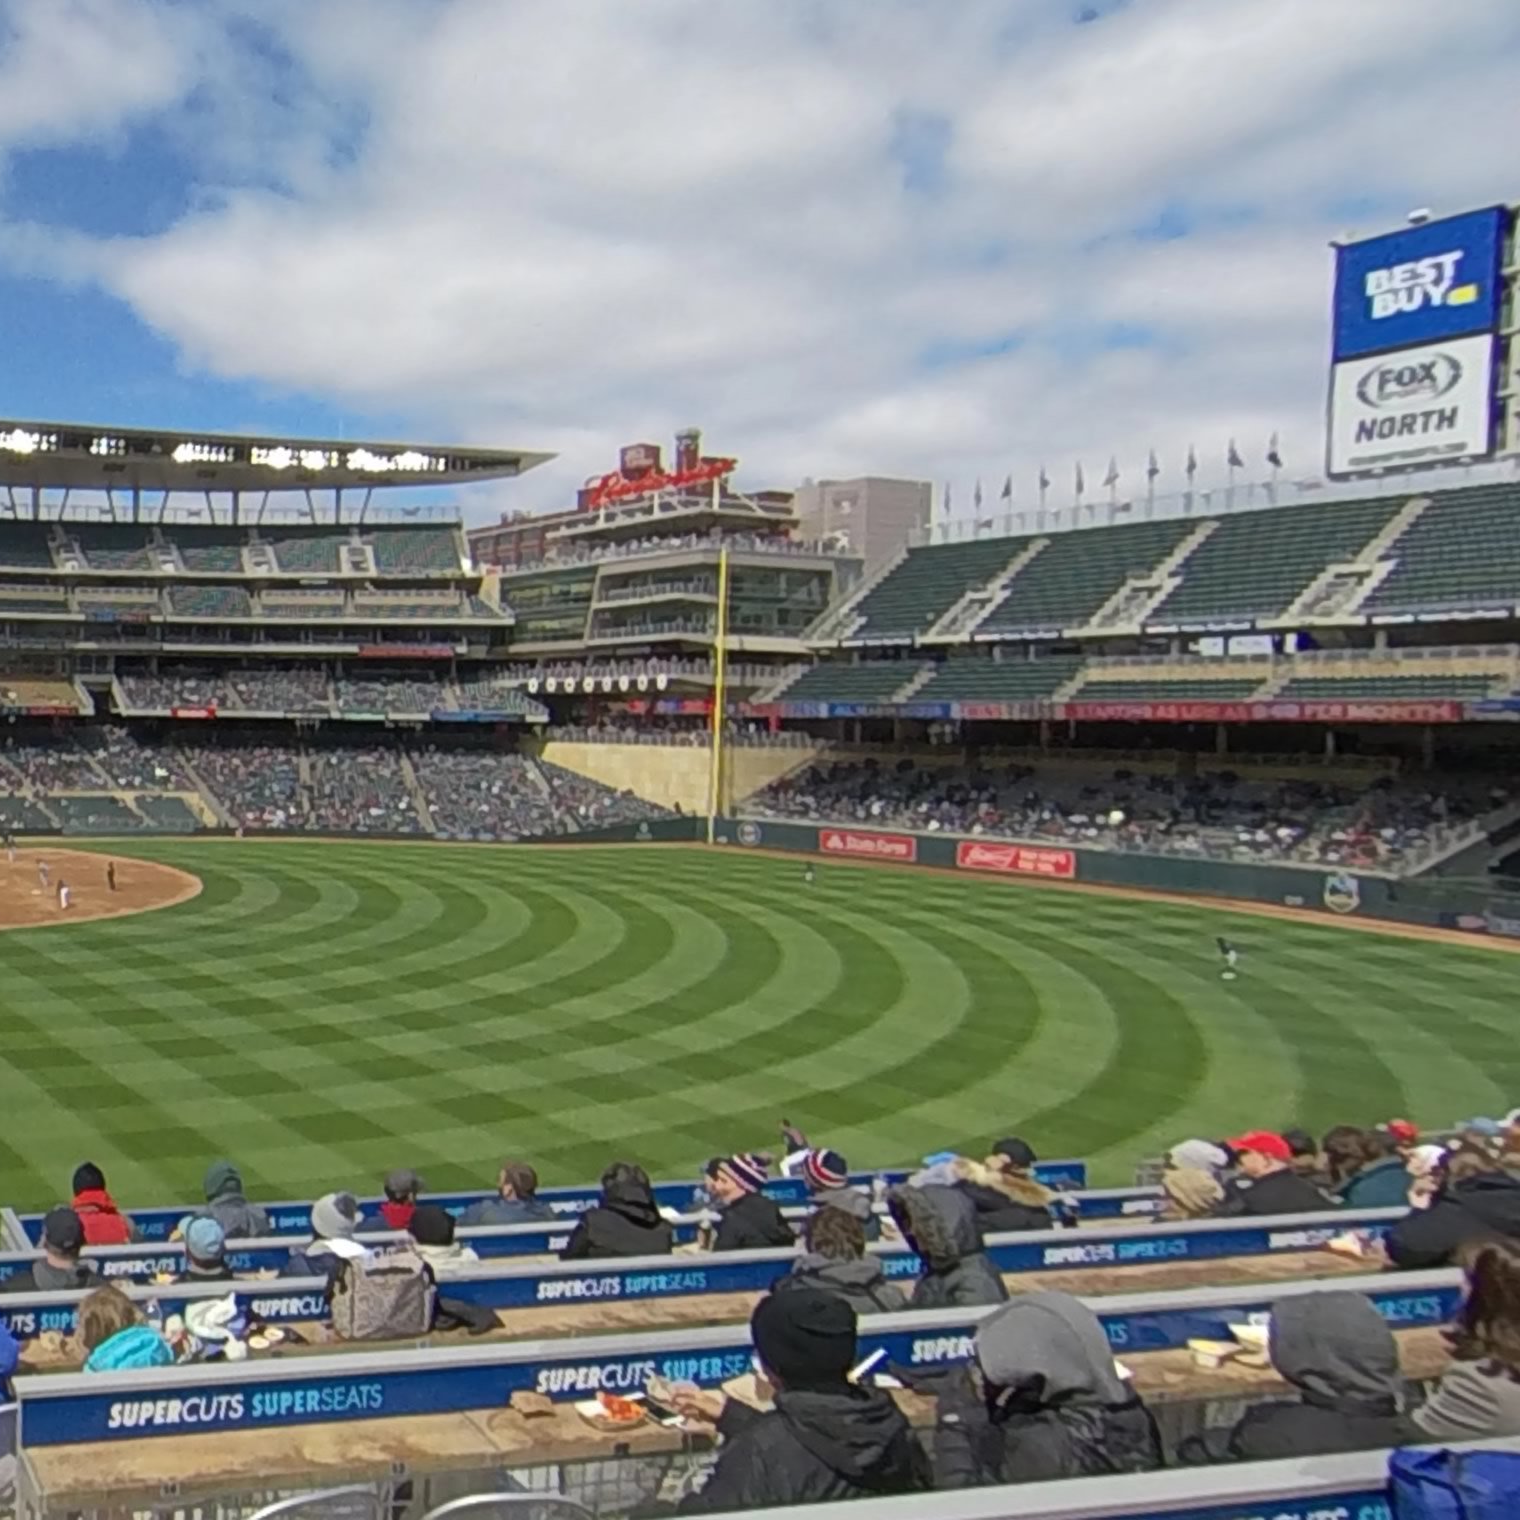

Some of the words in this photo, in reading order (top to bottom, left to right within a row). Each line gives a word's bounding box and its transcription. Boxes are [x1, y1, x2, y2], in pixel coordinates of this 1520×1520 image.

[1365, 250, 1464, 296] BEST
[1371, 283, 1452, 319] BUY
[1378, 360, 1440, 392] FOX
[1355, 406, 1458, 443] NORTH
[104, 1255, 176, 1275] SUPERCUTS
[536, 1276, 621, 1299] SUPERCUTS
[625, 1272, 707, 1292] SUPERSEATS
[537, 1361, 655, 1393] SUPERCUTS
[108, 1394, 244, 1428] SUPERCUTS
[252, 1384, 383, 1417] SUPERSEATS
